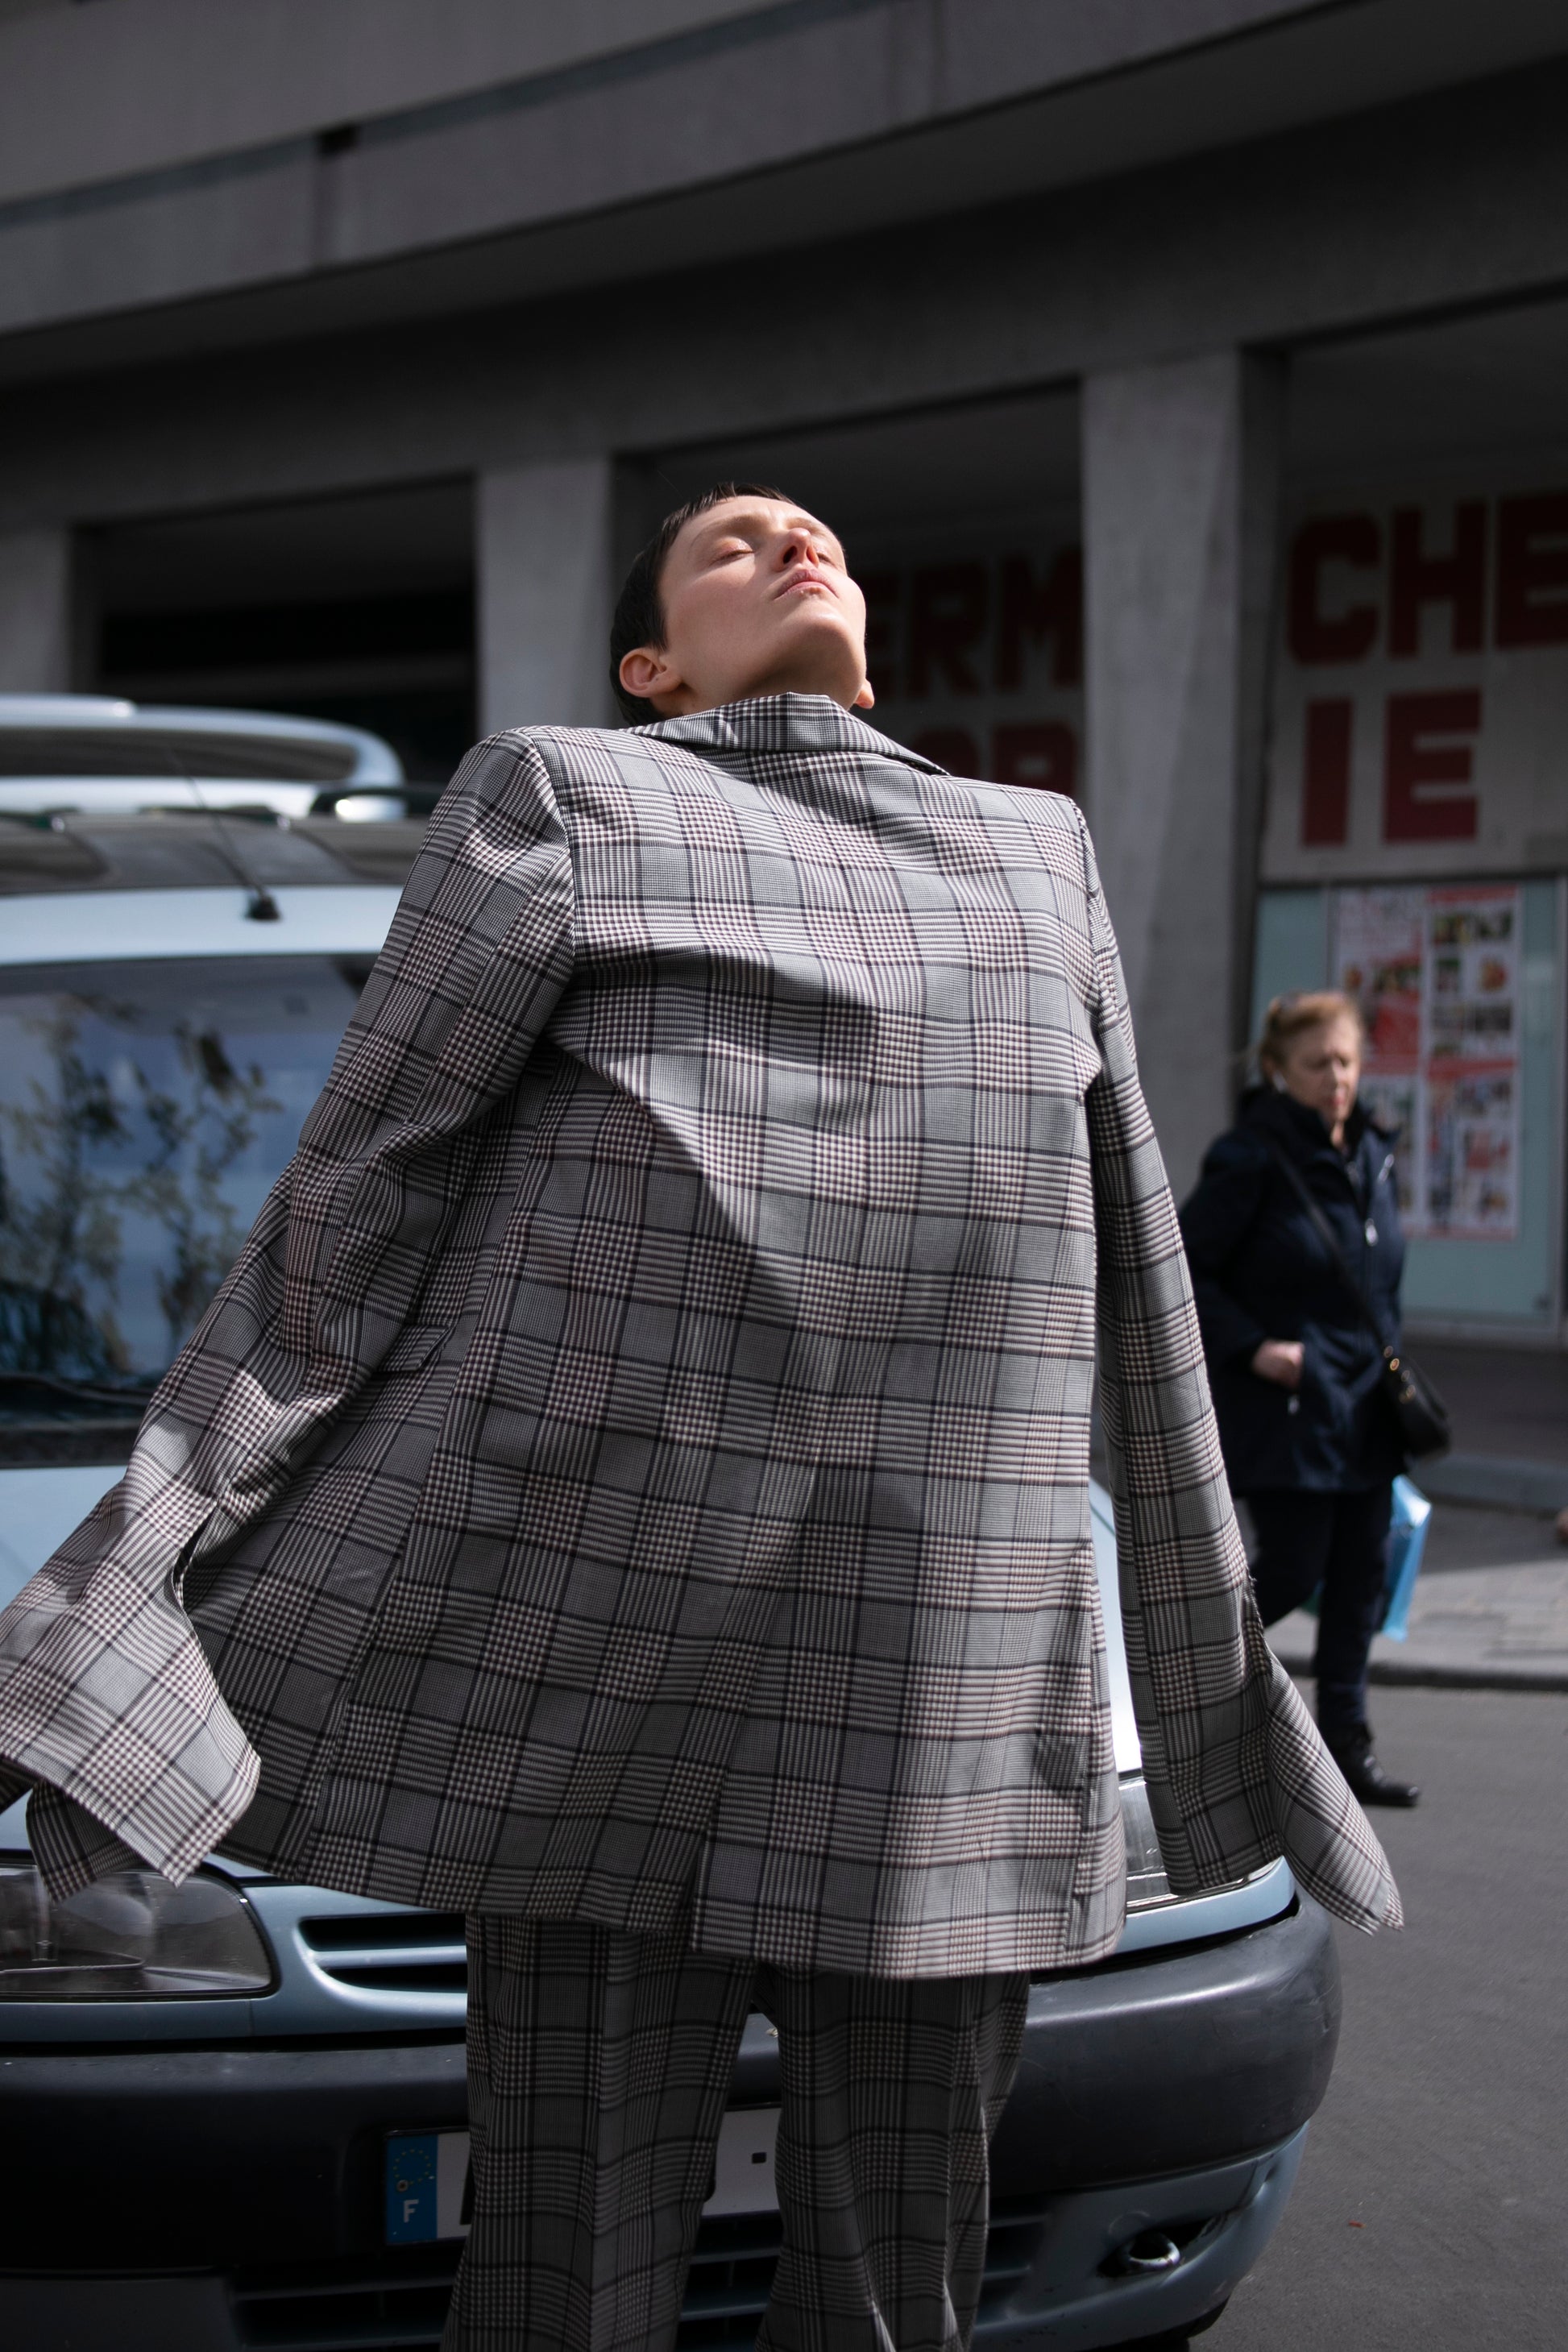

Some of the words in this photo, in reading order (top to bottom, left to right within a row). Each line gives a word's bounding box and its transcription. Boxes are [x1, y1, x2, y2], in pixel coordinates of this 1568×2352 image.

[1287, 493, 1568, 664] CHE
[1302, 686, 1482, 847] IE
[403, 2198, 419, 2223] F
